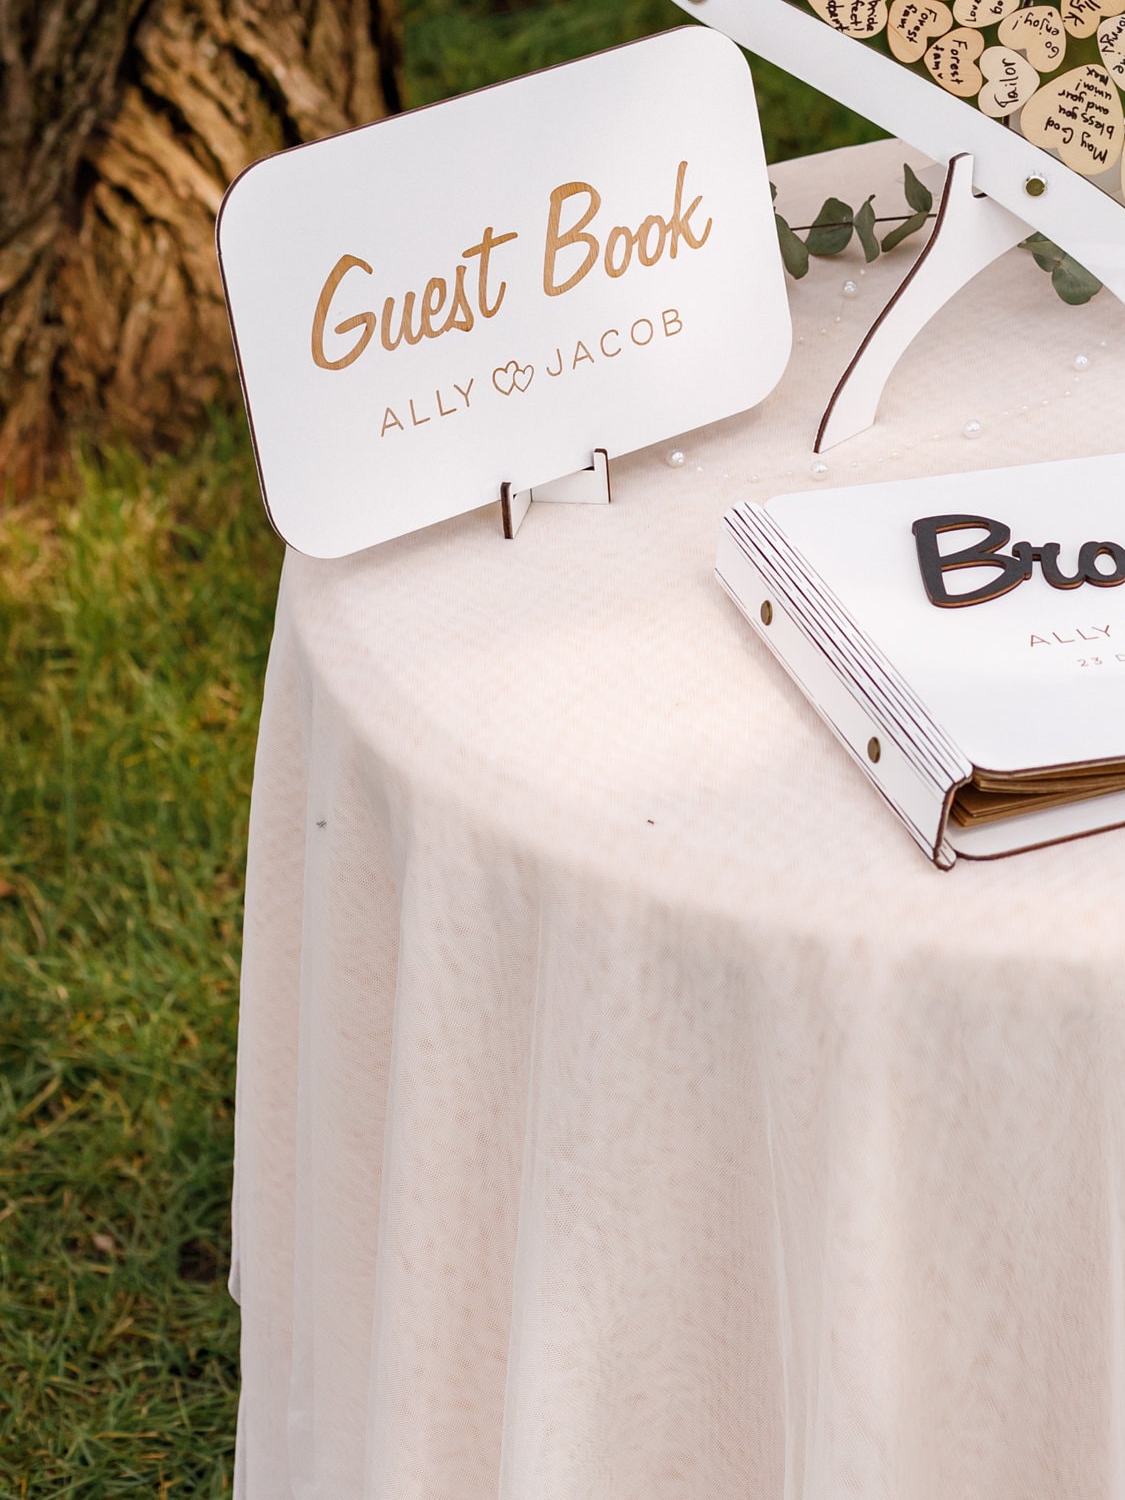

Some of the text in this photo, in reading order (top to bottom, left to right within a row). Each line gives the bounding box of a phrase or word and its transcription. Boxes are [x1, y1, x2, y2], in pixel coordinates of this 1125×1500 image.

[950, 39, 968, 85] Forest
[310, 160, 714, 371] Guest Book
[380, 307, 684, 437] ALLY JACOB
[1028, 623, 1112, 649] ALLY
[1077, 656, 1104, 668] 23
